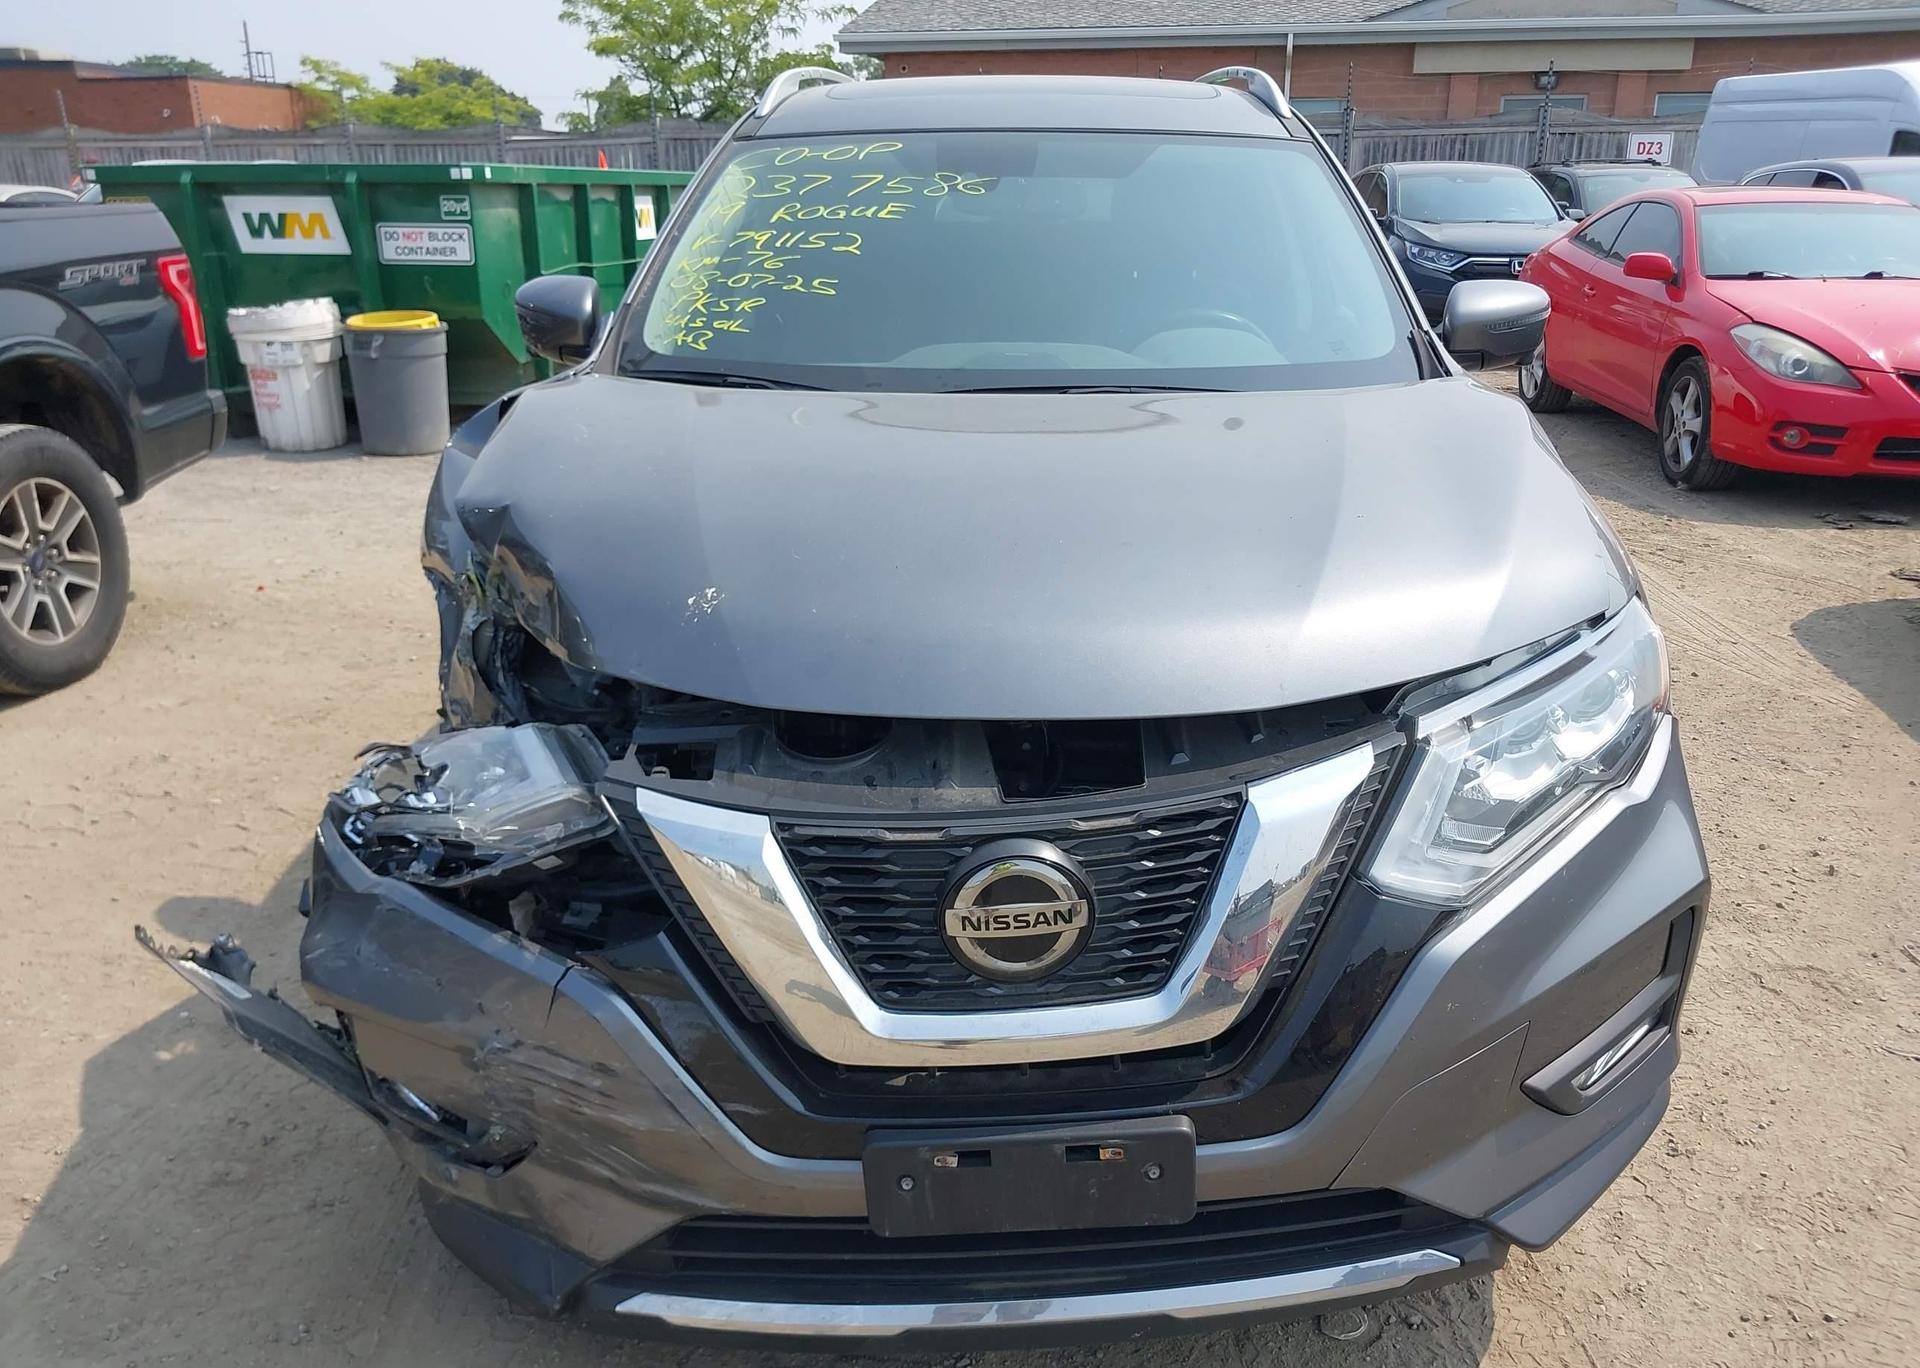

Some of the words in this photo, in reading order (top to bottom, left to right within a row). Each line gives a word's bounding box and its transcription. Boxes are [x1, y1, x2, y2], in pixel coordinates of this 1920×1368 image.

[1636, 141, 1663, 156] DZ3
[769, 203, 917, 223] ROGUE
[242, 212, 332, 240] WM
[384, 231, 400, 241] DO
[402, 231, 425, 241] NOT
[428, 231, 466, 242] BLOCK
[394, 246, 458, 257] CONTAINER
[58, 259, 147, 290] SPORT
[670, 271, 839, 295] 08-07-25
[960, 907, 1074, 932] NISSAN
